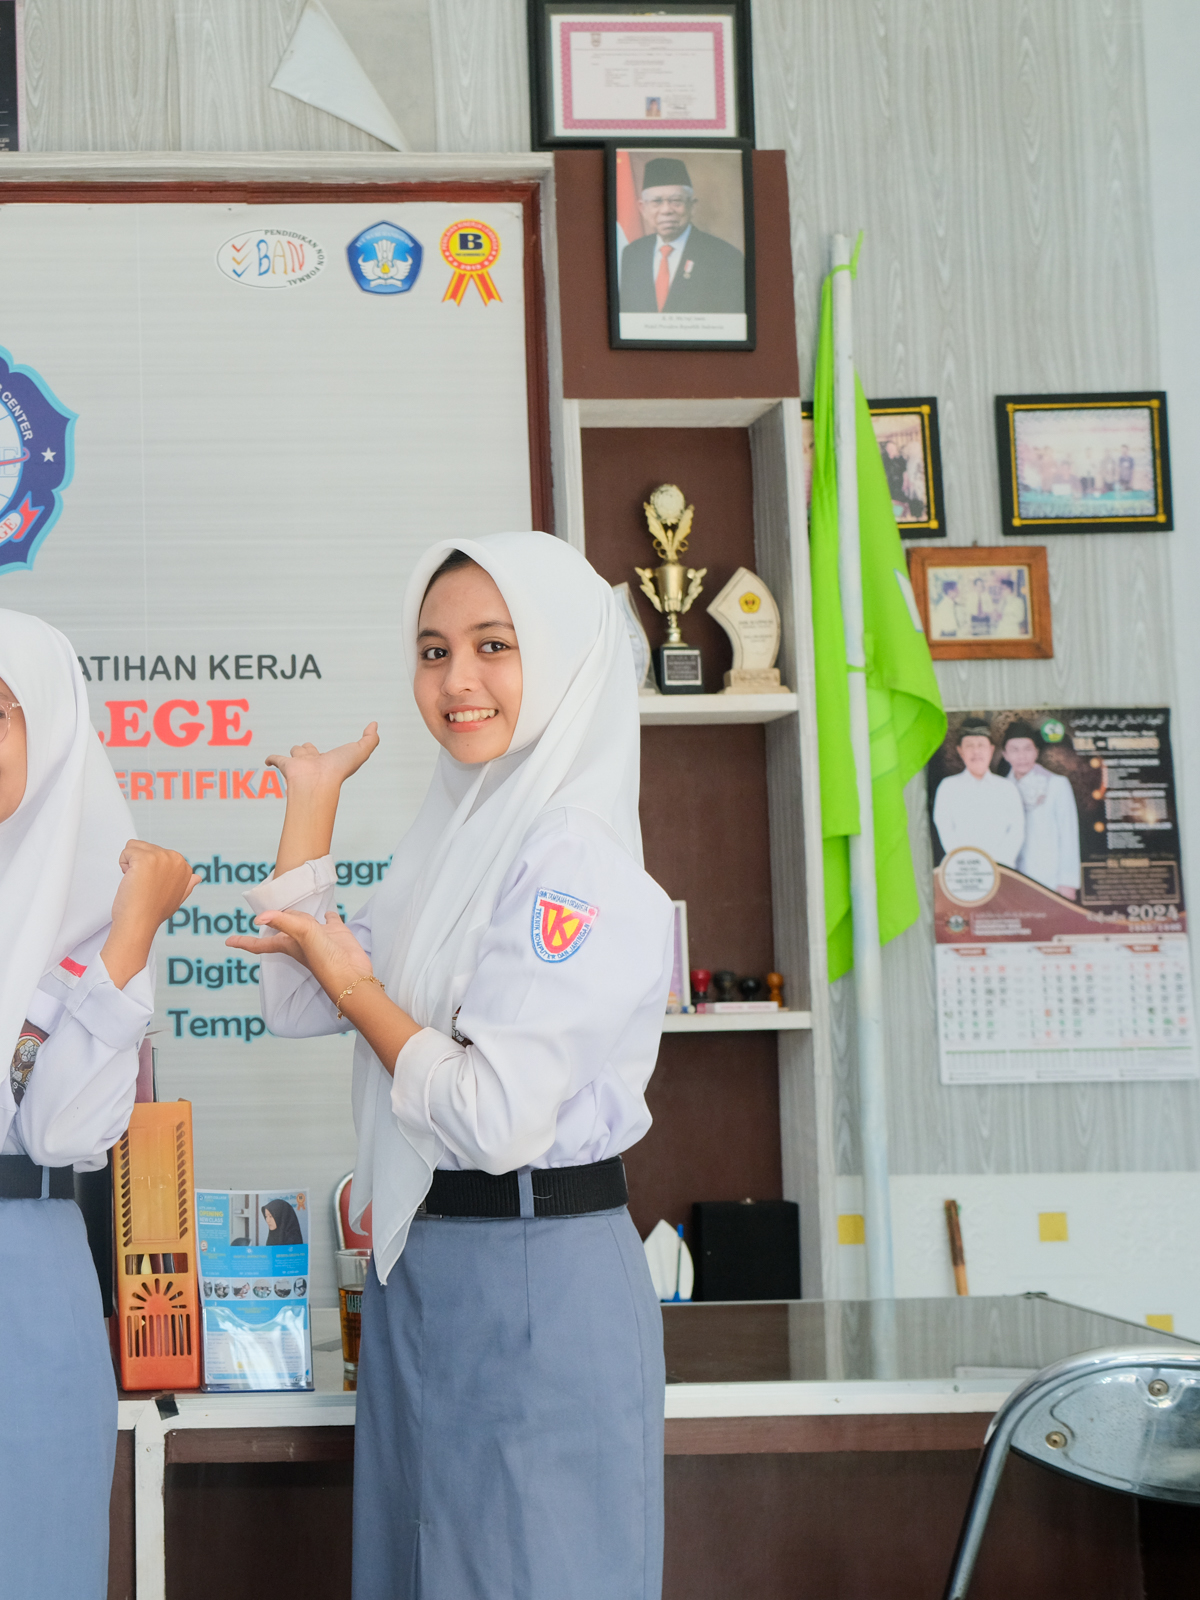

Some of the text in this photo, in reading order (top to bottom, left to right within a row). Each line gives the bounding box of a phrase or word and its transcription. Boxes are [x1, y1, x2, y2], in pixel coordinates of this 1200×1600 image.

[264, 229, 319, 249] PENDIDIKAN
[459, 233, 483, 250] B
[256, 239, 305, 276] BAN
[1, 391, 33, 441] CENTER
[77, 655, 196, 682] ATIHAN
[209, 653, 323, 680] KERJA
[191, 856, 275, 883] ahas
[1127, 904, 1178, 922] 2024
[168, 958, 260, 989] Digit
[168, 1010, 266, 1042] Temp
